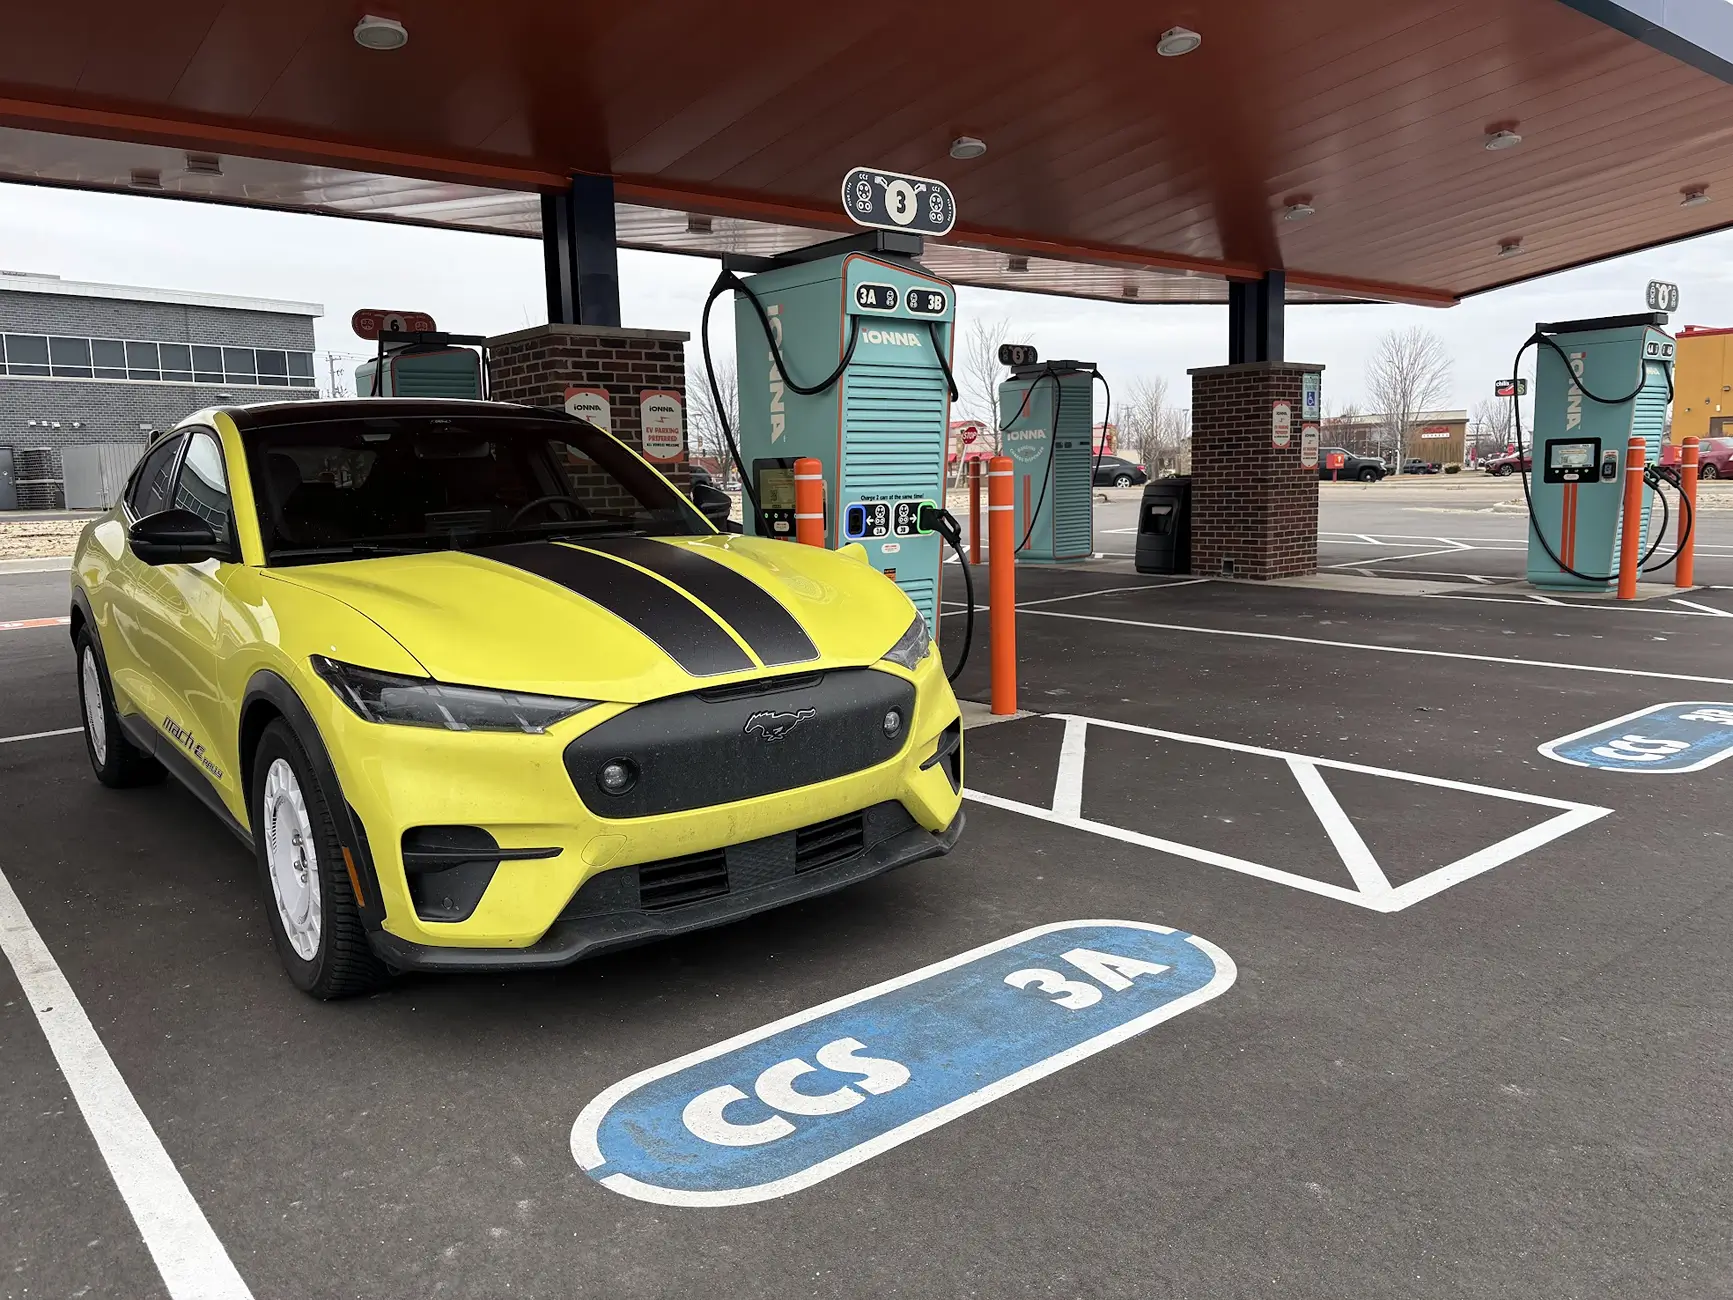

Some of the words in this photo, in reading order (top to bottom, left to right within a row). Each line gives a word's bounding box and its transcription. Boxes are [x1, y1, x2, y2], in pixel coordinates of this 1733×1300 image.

[931, 185, 941, 193] CCS
[896, 189, 906, 214] 3
[859, 288, 877, 305] 3A
[927, 294, 943, 311] 3B
[390, 319, 400, 332] 6
[645, 426, 654, 434] EV
[963, 431, 977, 440] STOP
[1591, 734, 1692, 762] CCS
[1003, 947, 1171, 1010] 3A
[682, 1036, 911, 1147] CCS
